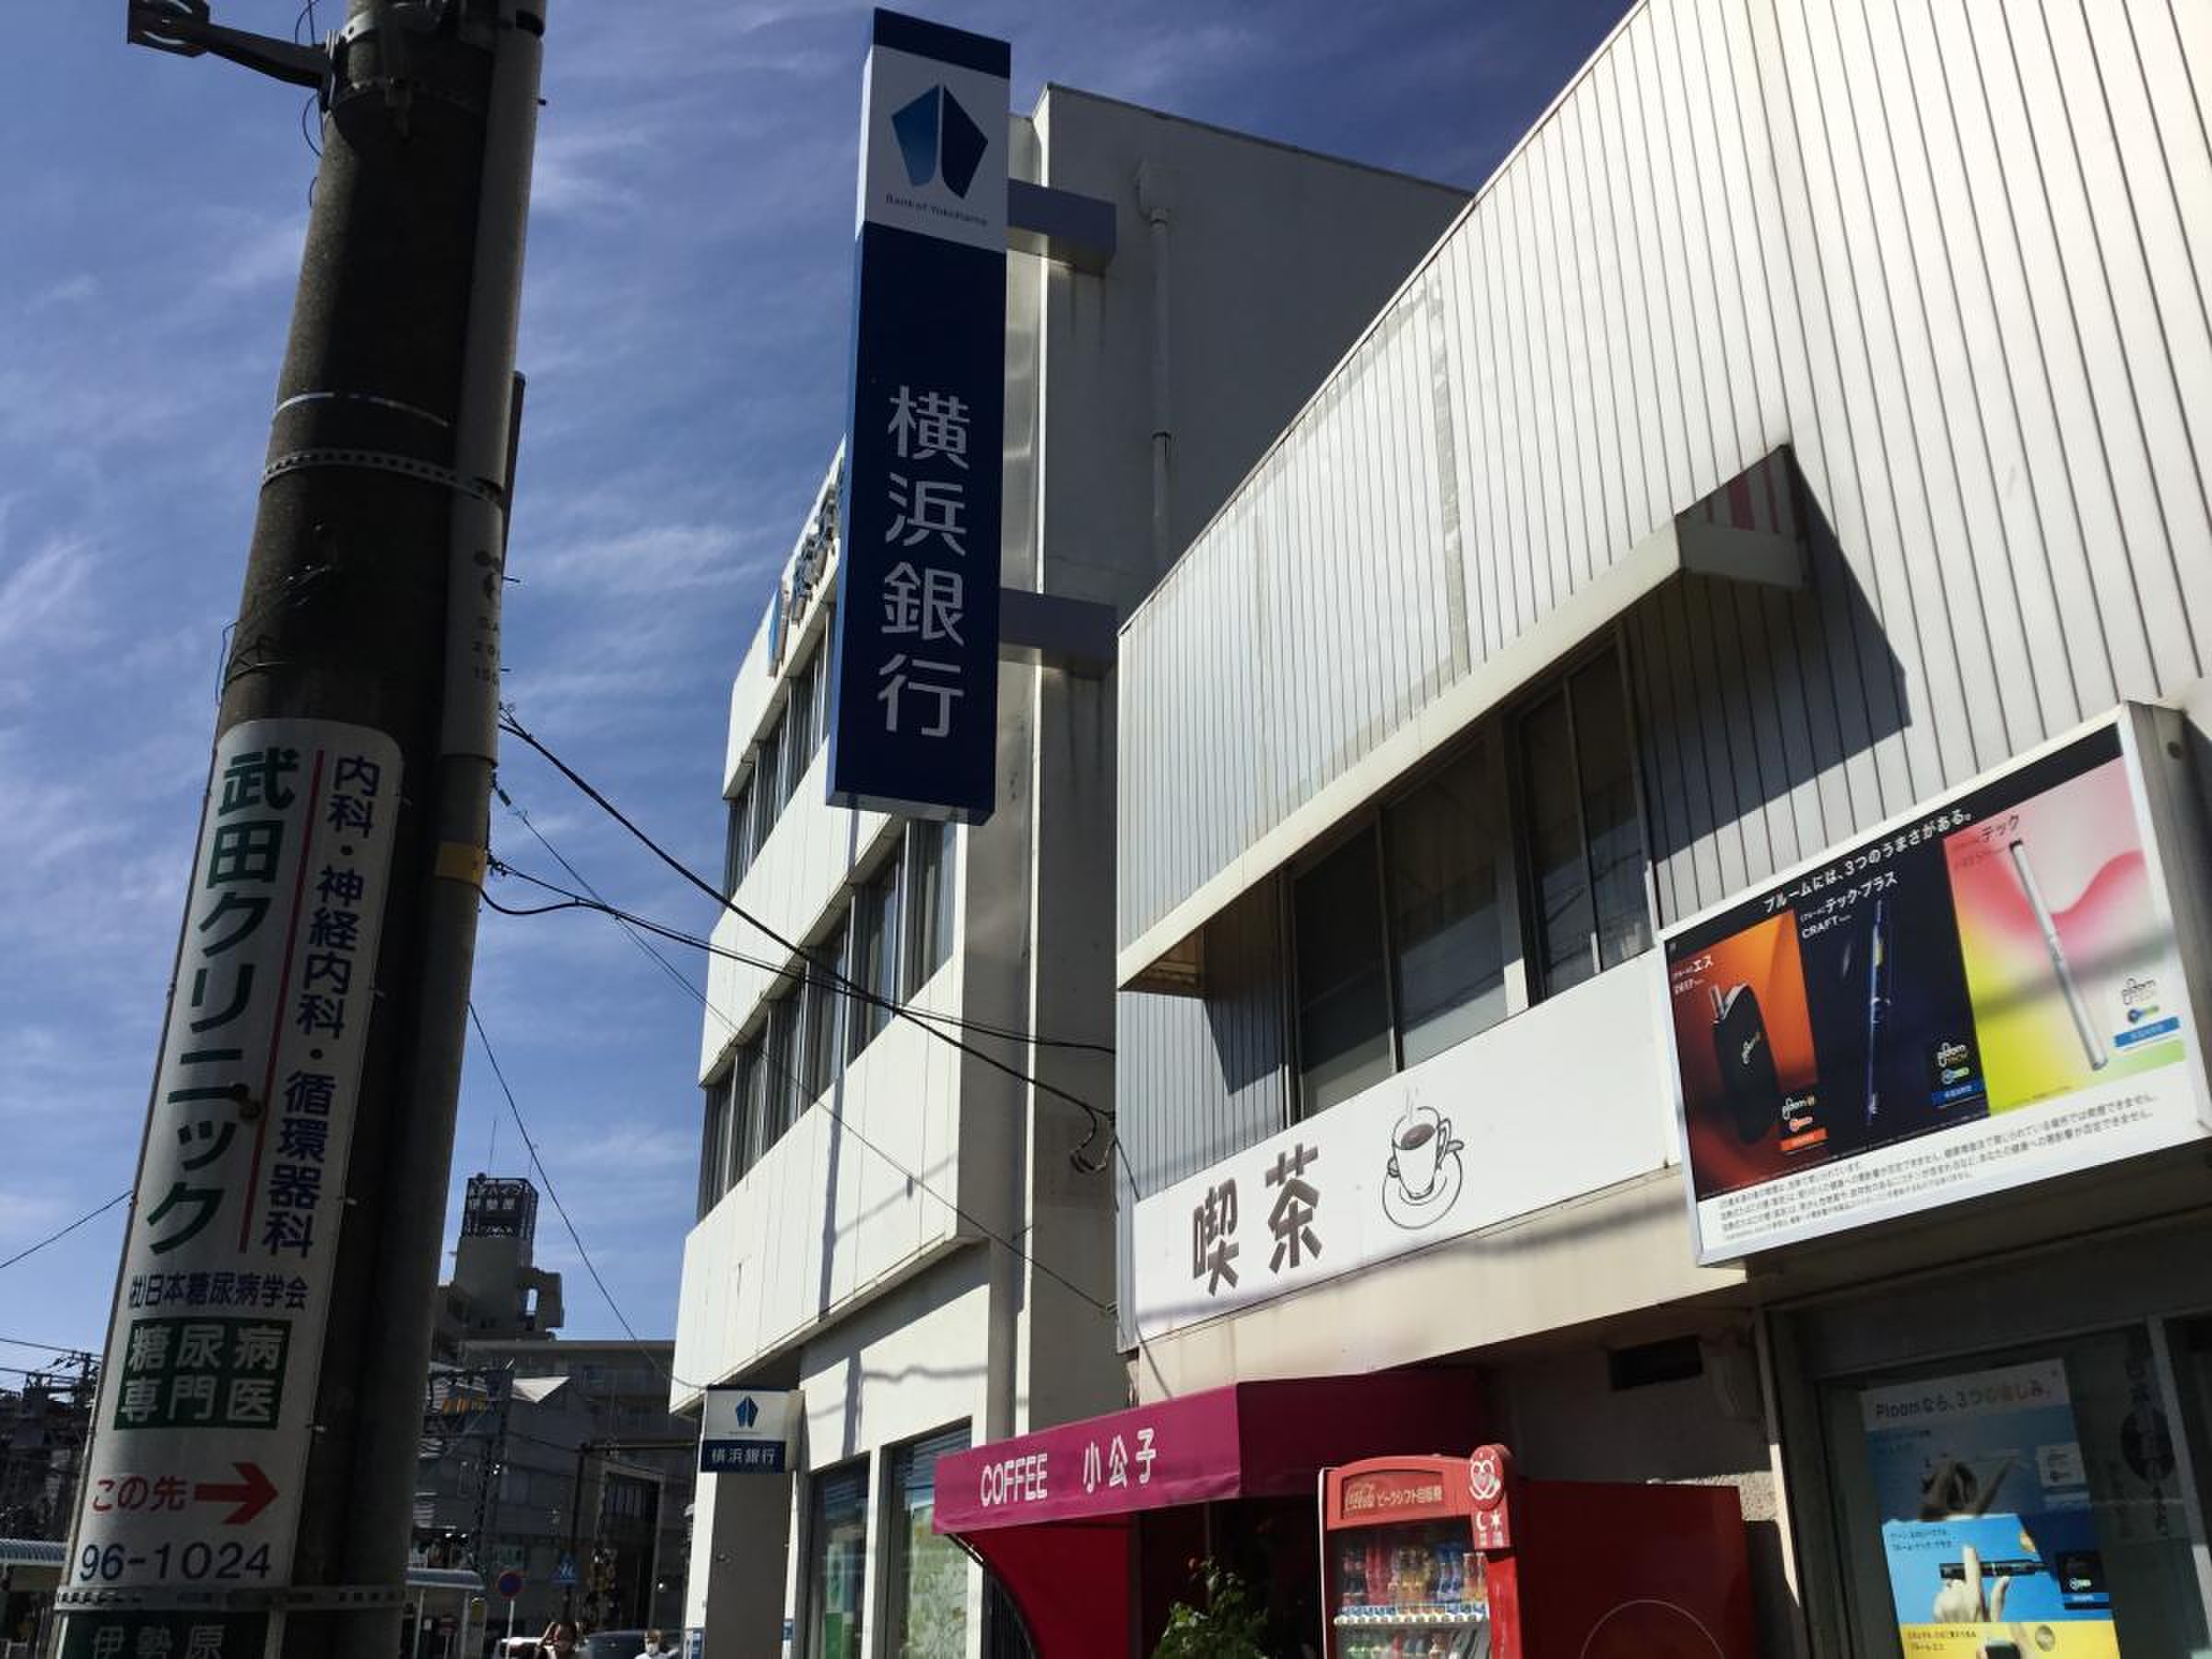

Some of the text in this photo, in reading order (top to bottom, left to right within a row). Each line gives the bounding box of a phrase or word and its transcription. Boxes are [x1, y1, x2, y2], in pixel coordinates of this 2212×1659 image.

[877, 384, 970, 737] 横浜銀行
[1801, 916, 1840, 939] CRAFT
[147, 746, 300, 1255] 武田クリニック
[1192, 1142, 1324, 1297] 喫茶
[127, 1323, 285, 1372] 糖尿病
[120, 1376, 276, 1423] 専門医
[980, 1428, 1158, 1508] COFFEE 小公子
[91, 1477, 186, 1513] この先
[79, 1542, 272, 1583] 96-1024
[91, 1624, 227, 1659] 伊勢原
